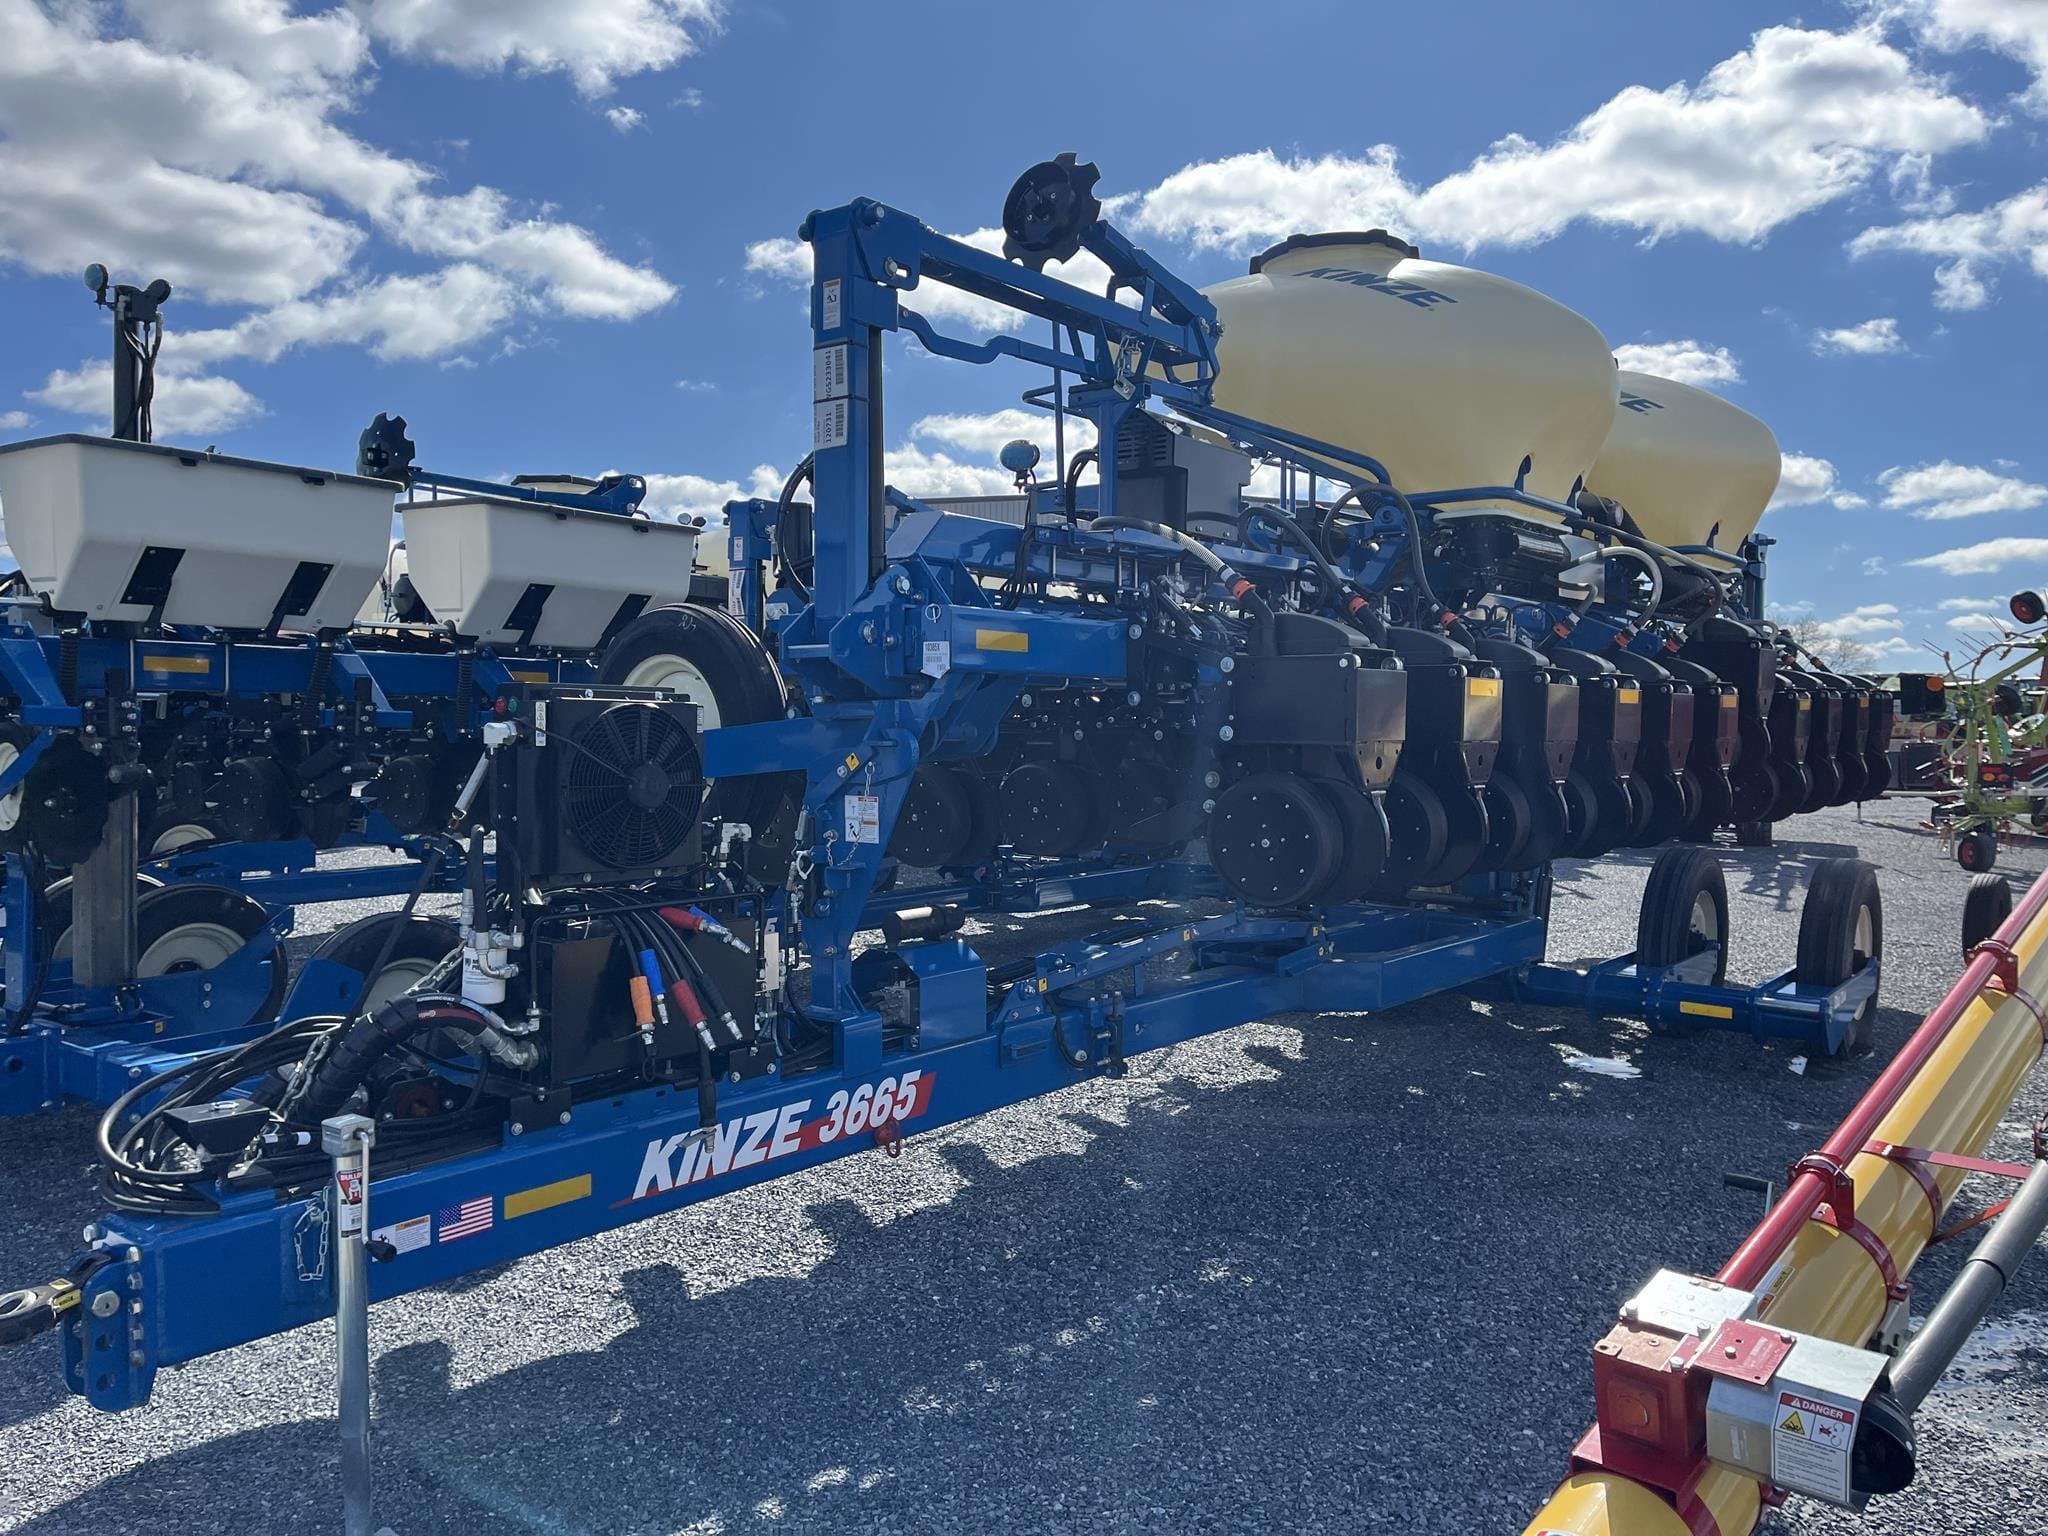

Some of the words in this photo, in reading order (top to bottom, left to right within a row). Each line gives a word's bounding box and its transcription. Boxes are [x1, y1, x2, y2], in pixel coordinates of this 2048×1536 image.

[1291, 267, 1459, 308] KINZE
[632, 1099, 812, 1200] KINZE
[818, 1069, 922, 1143] 3665
[1802, 1400, 1844, 1420] DANGER
